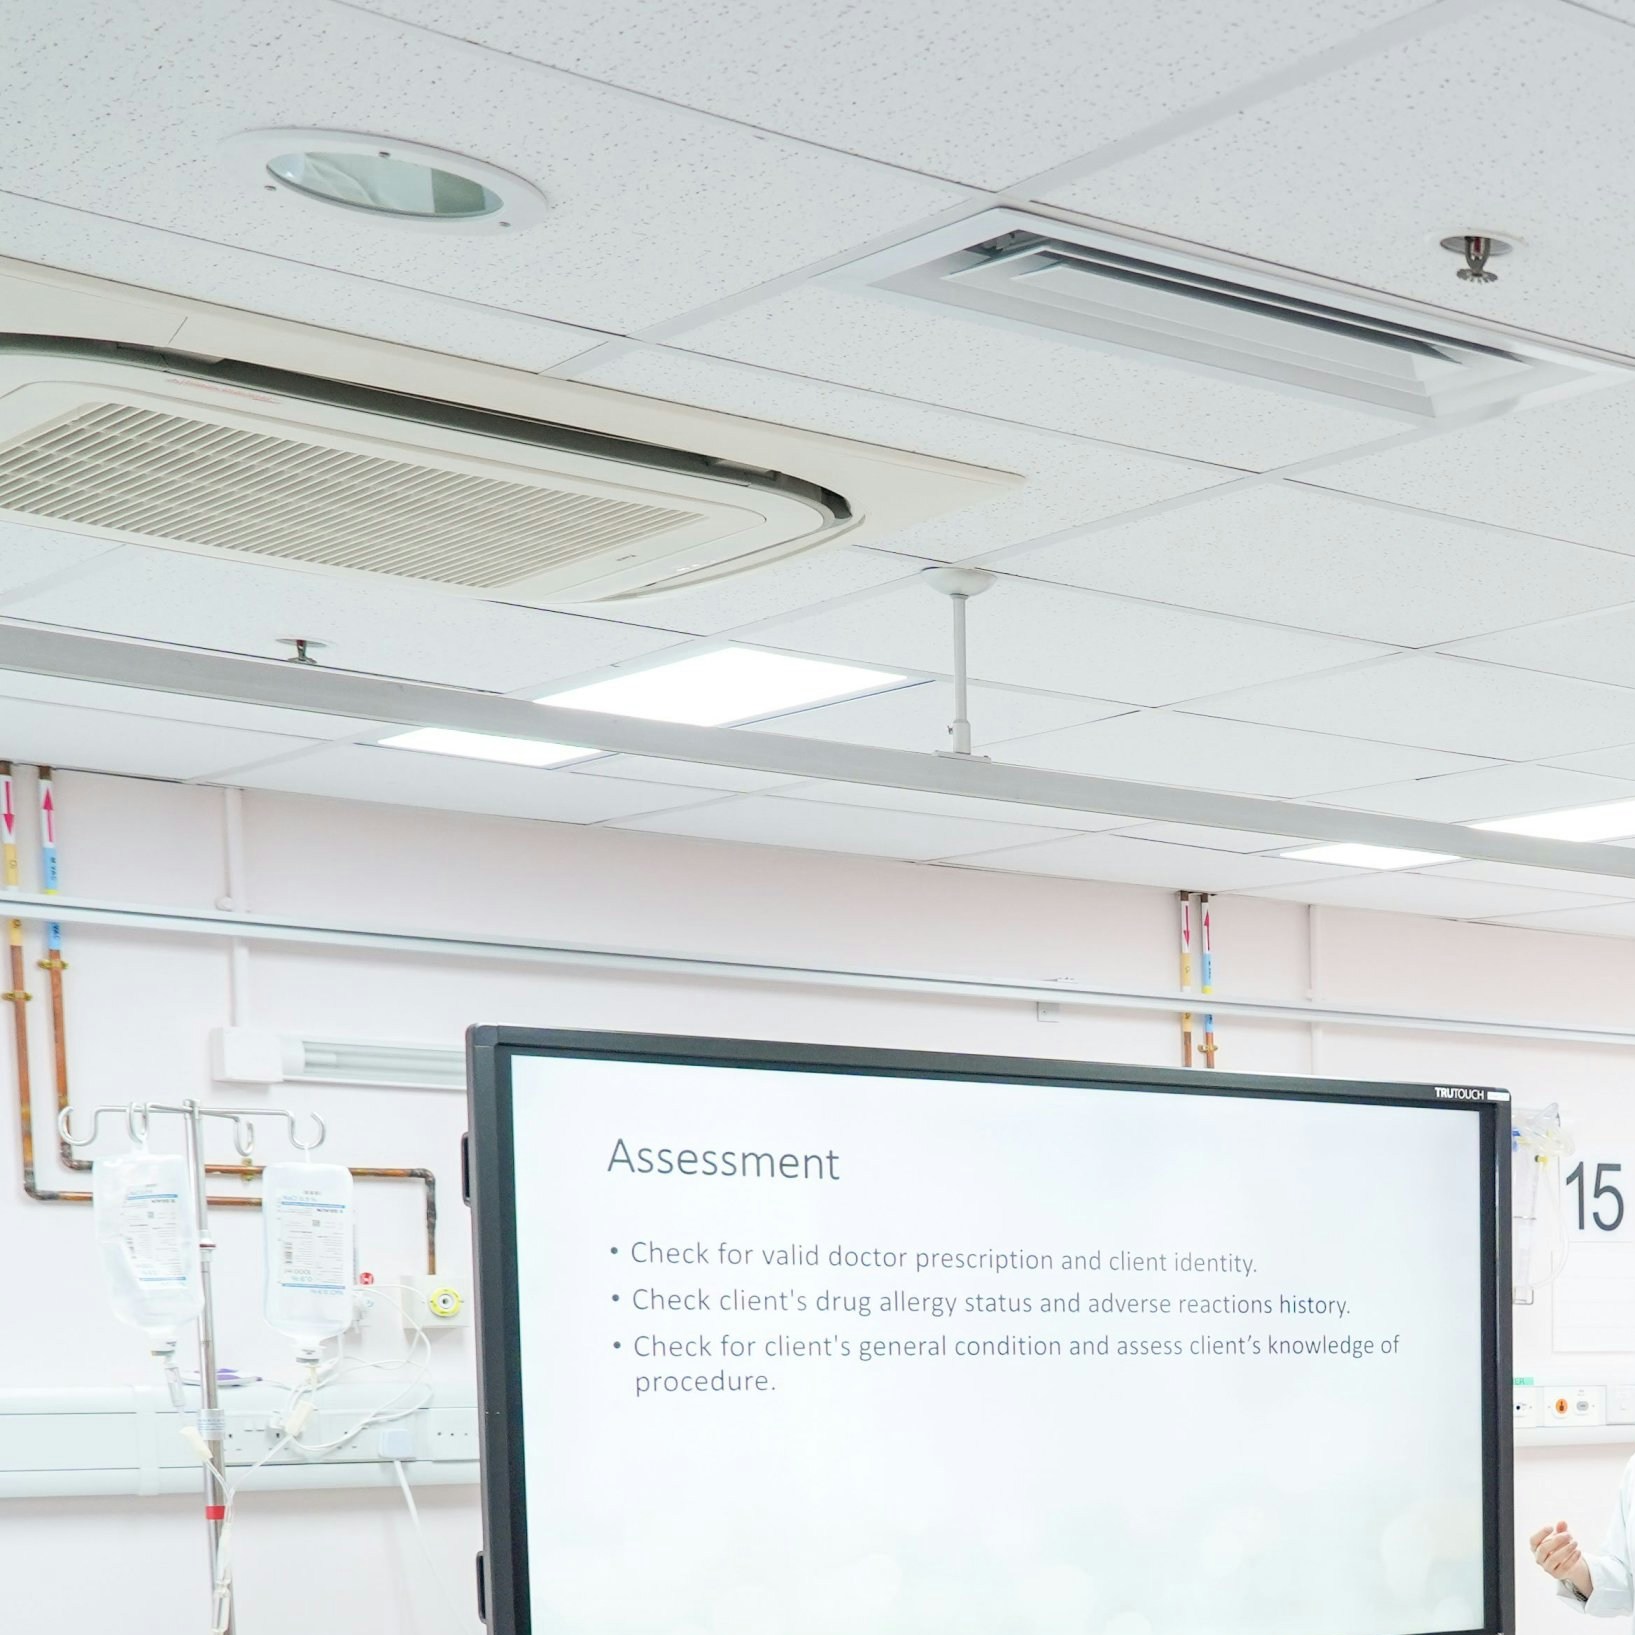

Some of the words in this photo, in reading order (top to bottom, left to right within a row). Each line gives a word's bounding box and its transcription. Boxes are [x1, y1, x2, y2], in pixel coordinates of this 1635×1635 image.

[1434, 1086, 1485, 1101] TRUTOUCH
[607, 1137, 841, 1181] Assessment
[1565, 1160, 1625, 1231] 15
[632, 1241, 709, 1264] Check
[718, 1242, 754, 1264] for
[762, 1244, 818, 1266] valid
[829, 1244, 907, 1267] doctor
[917, 1248, 1053, 1274] prescription
[1062, 1250, 1101, 1270] and
[1110, 1250, 1167, 1271] client
[1175, 1252, 1257, 1277] identity.
[633, 1288, 710, 1310] Check
[720, 1289, 807, 1311] client's
[816, 1289, 871, 1317] drug
[880, 1290, 957, 1317] allergy
[965, 1293, 1032, 1312] status
[1040, 1292, 1080, 1312] and
[1089, 1292, 1171, 1313] adverse
[1179, 1294, 1273, 1314] reactions
[1279, 1294, 1351, 1319] history.
[634, 1334, 712, 1357] Check
[720, 1334, 756, 1356] for
[765, 1334, 850, 1356] client's
[860, 1335, 945, 1361] general
[955, 1335, 1061, 1356] condition
[1070, 1335, 1109, 1355] and
[1117, 1340, 1183, 1355] assess
[1268, 1335, 1375, 1358] knowledge
[1381, 1334, 1400, 1354] of
[636, 1369, 776, 1397] procedure.
